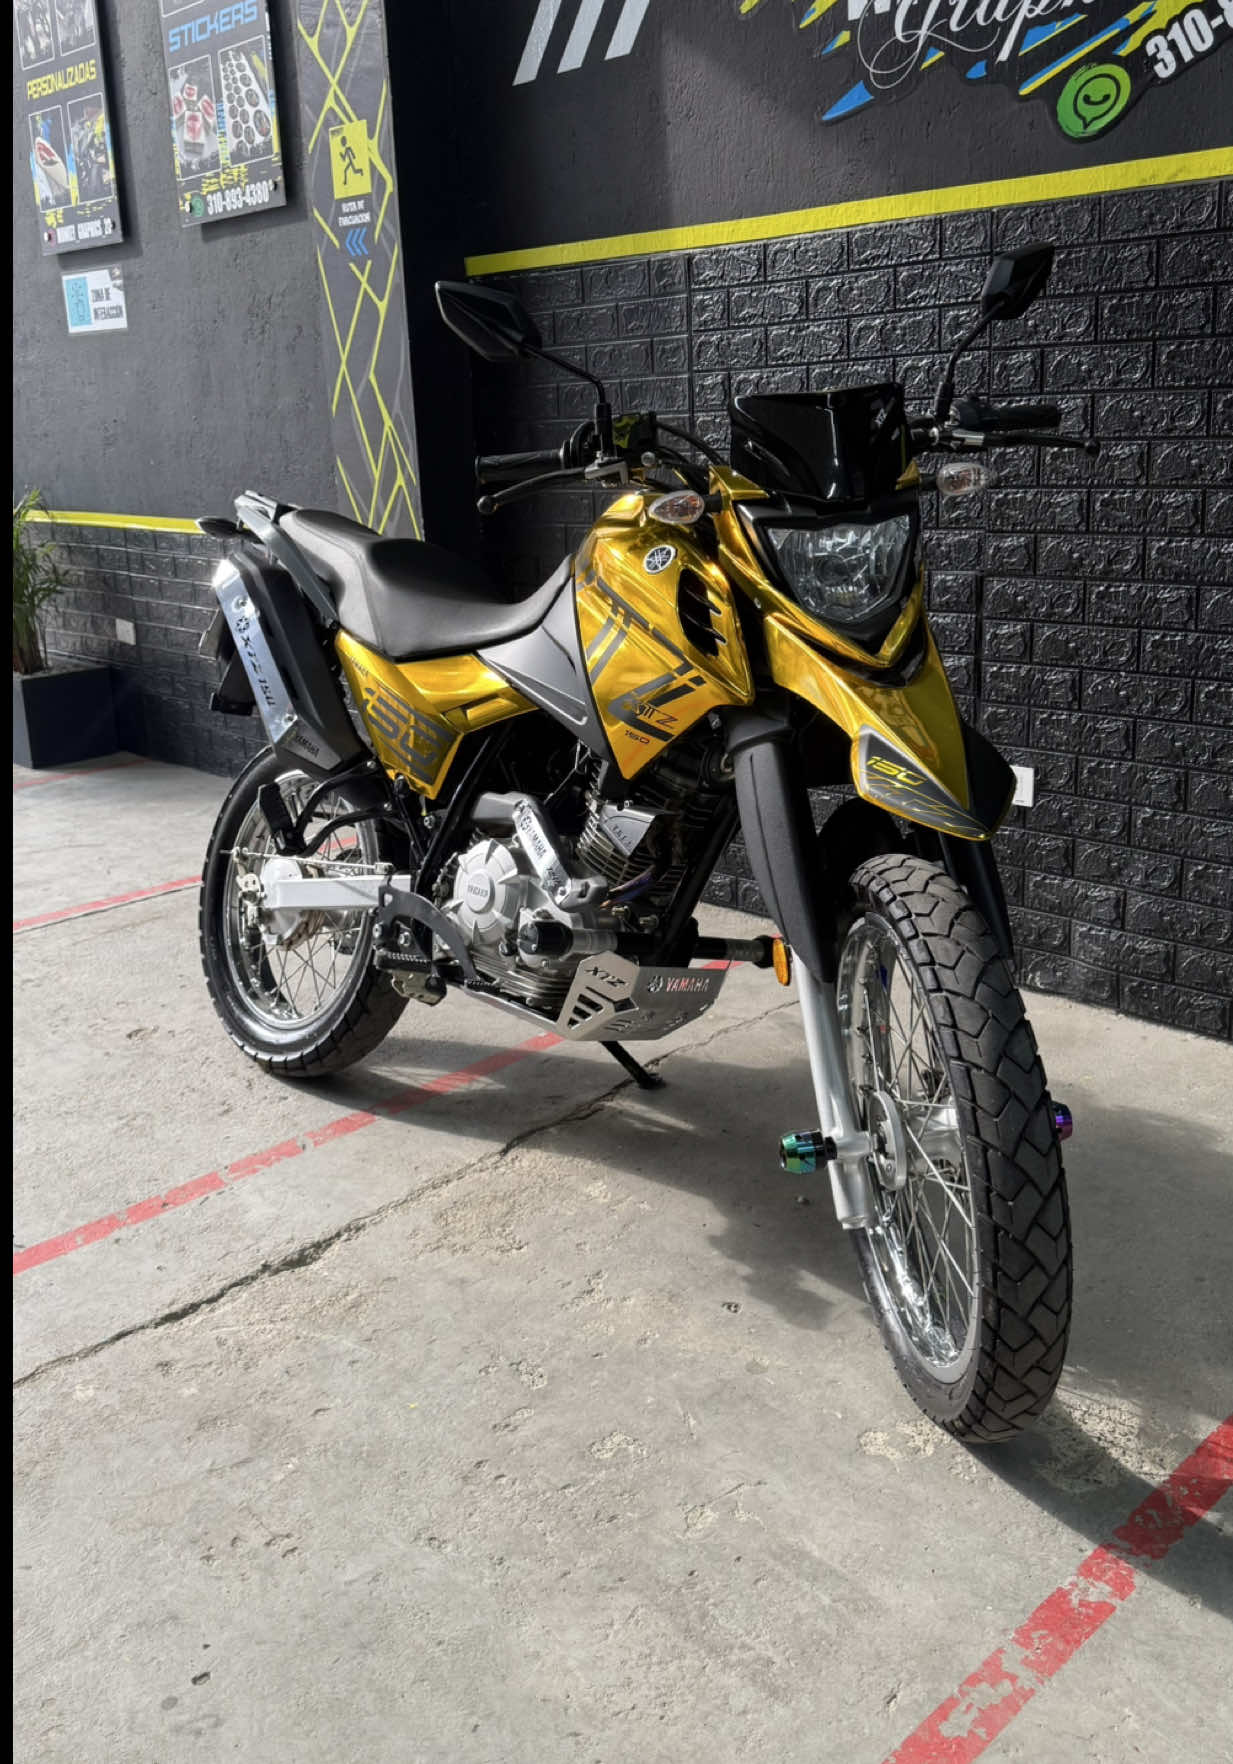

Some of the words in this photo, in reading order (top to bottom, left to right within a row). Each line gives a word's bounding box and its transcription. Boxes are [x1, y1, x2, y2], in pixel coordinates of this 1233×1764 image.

[168, 0, 257, 53] STICKERS
[866, 756, 928, 786] 150
[666, 976, 710, 992] YAMAHA
